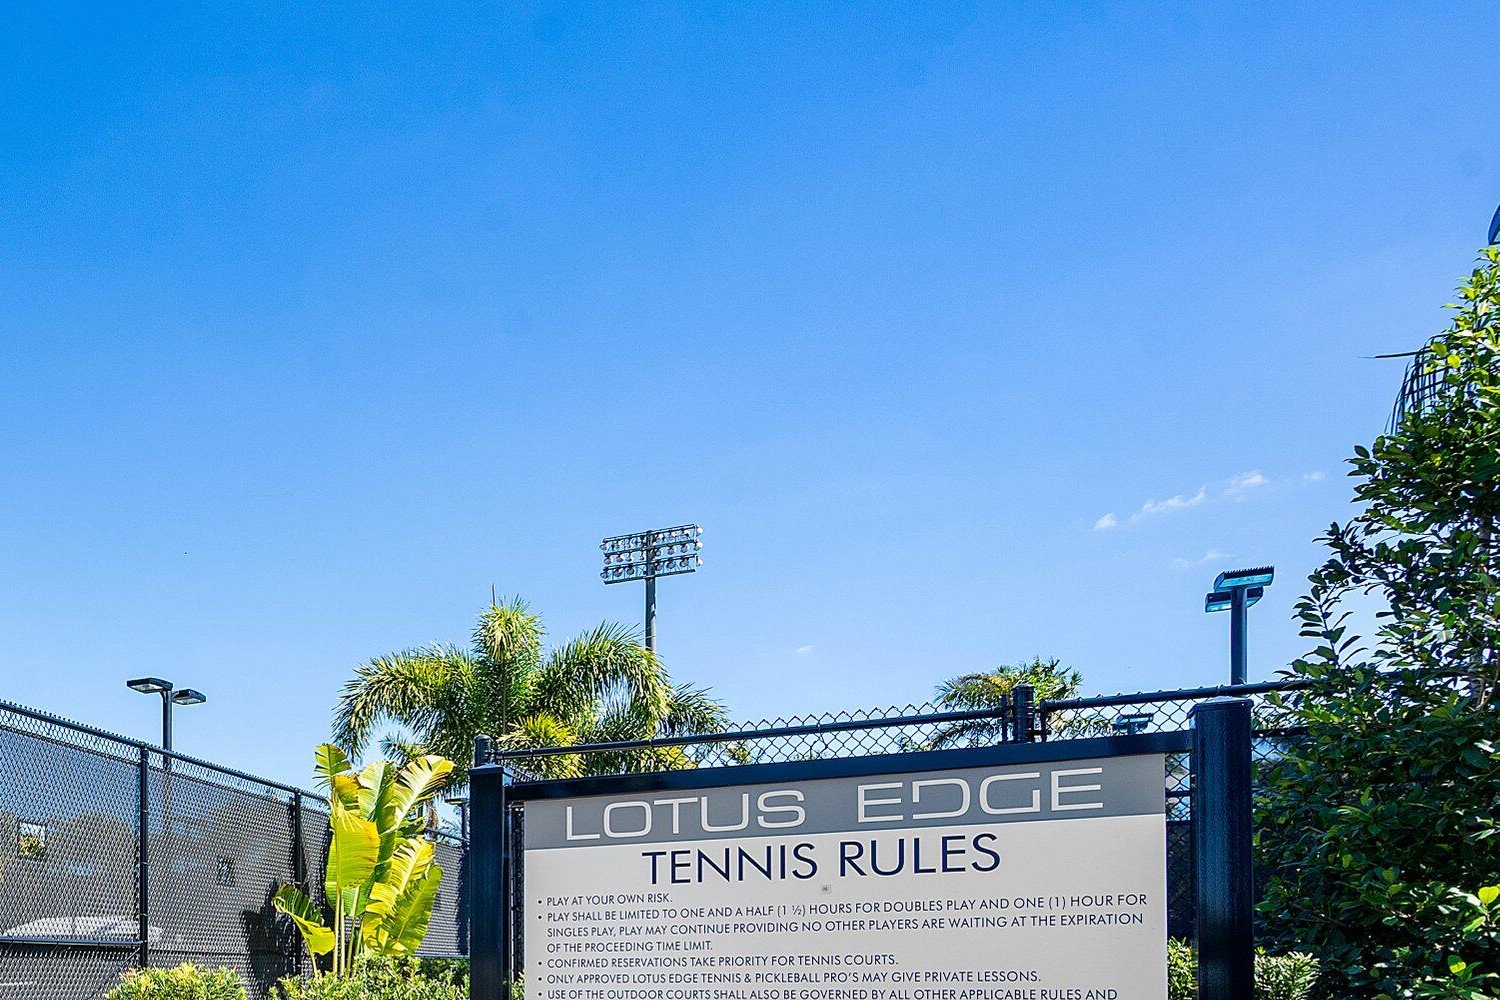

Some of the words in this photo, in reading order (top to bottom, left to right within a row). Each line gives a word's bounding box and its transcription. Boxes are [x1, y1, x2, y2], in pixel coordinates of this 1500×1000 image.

[565, 788, 806, 841] LOTUS
[857, 767, 1104, 822] EDGE
[641, 842, 818, 885] TENNIS
[839, 832, 1002, 878] RULES
[546, 896, 570, 907] PLAY
[570, 895, 584, 906] AT
[585, 894, 616, 906] YOUR
[616, 893, 645, 905] OWN
[647, 892, 673, 904] RISK.
[546, 957, 609, 969] CONFIRMED
[611, 956, 688, 969] RESERVATIONS
[689, 956, 716, 968] TAKE
[718, 955, 769, 967] PRIORITY
[771, 955, 796, 967] FOR
[797, 954, 842, 967] TENNIS
[843, 953, 899, 966] COURTS.
[546, 973, 575, 985] ONLY
[575, 973, 631, 985] APPROVED
[632, 973, 667, 985] LOTUS
[668, 972, 699, 984] EDGE
[700, 972, 742, 984] TENNIS
[743, 972, 752, 984] &
[754, 972, 821, 984] PICKLEBALL
[823, 971, 860, 984] PRO'S
[861, 971, 889, 983] MAY
[890, 971, 921, 983] GIVE
[924, 970, 974, 983] PRIVATE
[977, 970, 1042, 983] LESSONS.
[547, 989, 567, 1000] USE
[568, 989, 584, 1000] OF
[584, 989, 605, 1000] THE
[606, 989, 664, 1000] OUTDOOR
[665, 989, 712, 1000] COURTS
[713, 989, 748, 1000] SHALL
[748, 988, 781, 1000] ALSO
[783, 988, 797, 1000] BE
[799, 988, 869, 1000] GOVERNED
[871, 988, 887, 1000] BY
[888, 989, 911, 1000] ALL
[913, 988, 957, 1000] OTHER
[959, 988, 1037, 1000] APPLICABLE
[1040, 988, 1082, 1000] RULES
[1084, 988, 1118, 1000] AND
